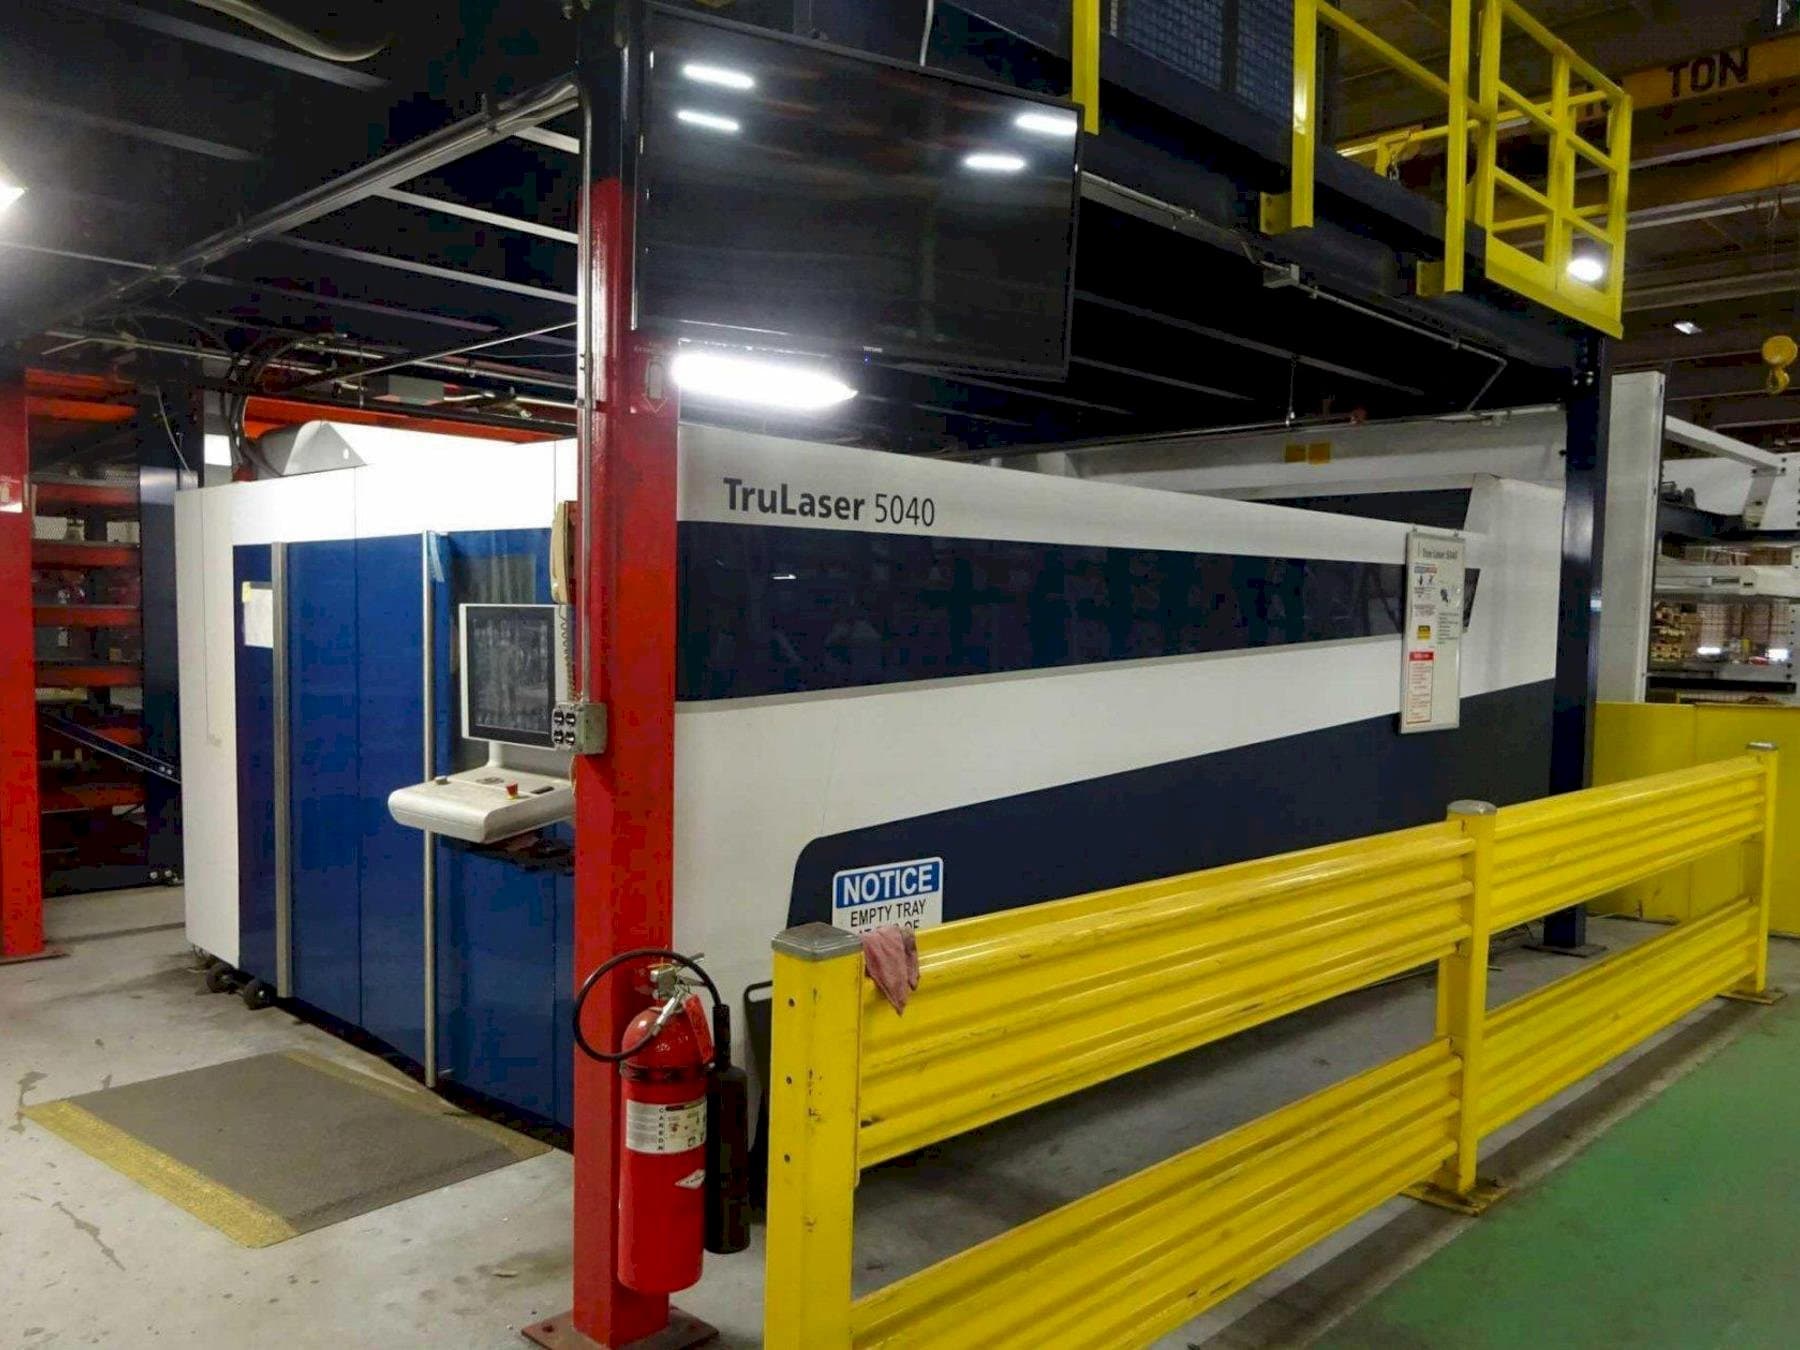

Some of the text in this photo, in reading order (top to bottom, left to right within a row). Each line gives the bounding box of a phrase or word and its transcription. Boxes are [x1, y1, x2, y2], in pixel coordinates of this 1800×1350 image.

[1667, 47, 1749, 99] TON
[722, 476, 936, 527] TruLaser 5040
[843, 863, 933, 906] NOTICE
[850, 898, 927, 927] EMPTY TRAY
